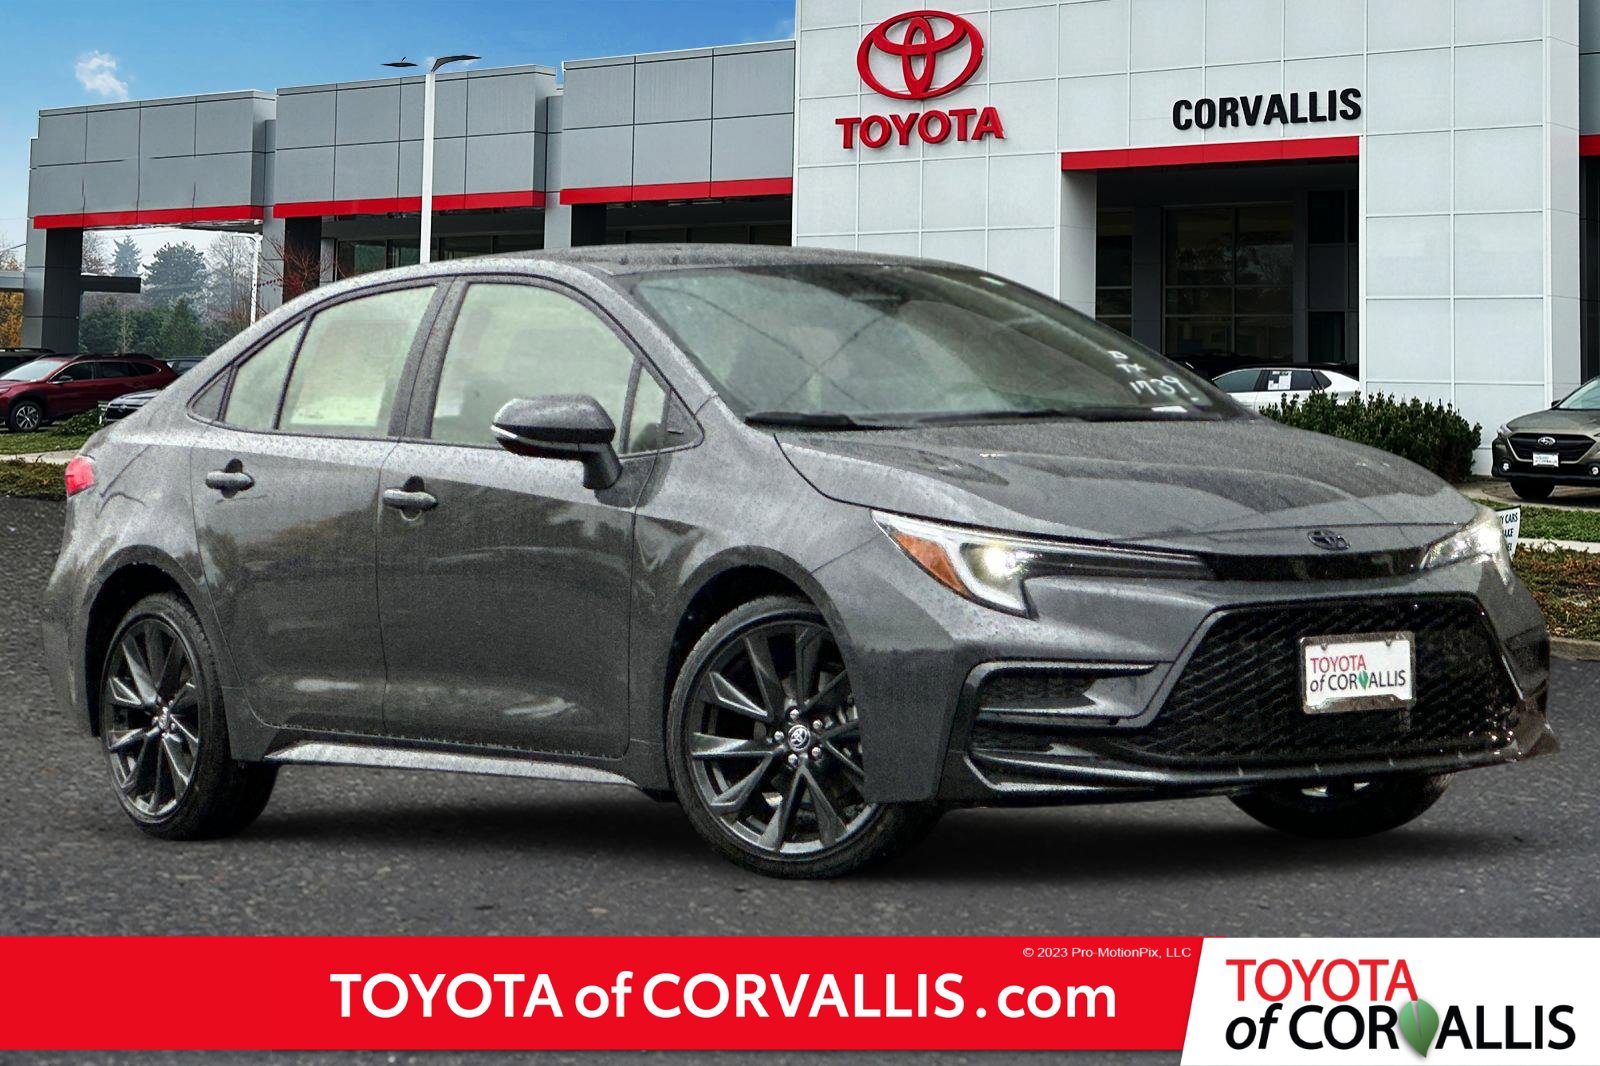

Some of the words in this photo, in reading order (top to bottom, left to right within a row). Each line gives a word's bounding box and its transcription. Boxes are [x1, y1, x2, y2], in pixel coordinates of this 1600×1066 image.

[1172, 87, 1362, 131] CORVALLIS
[836, 106, 1005, 149] TOYOTA
[1310, 654, 1367, 674] TOYOTA
[1310, 674, 1325, 693] of
